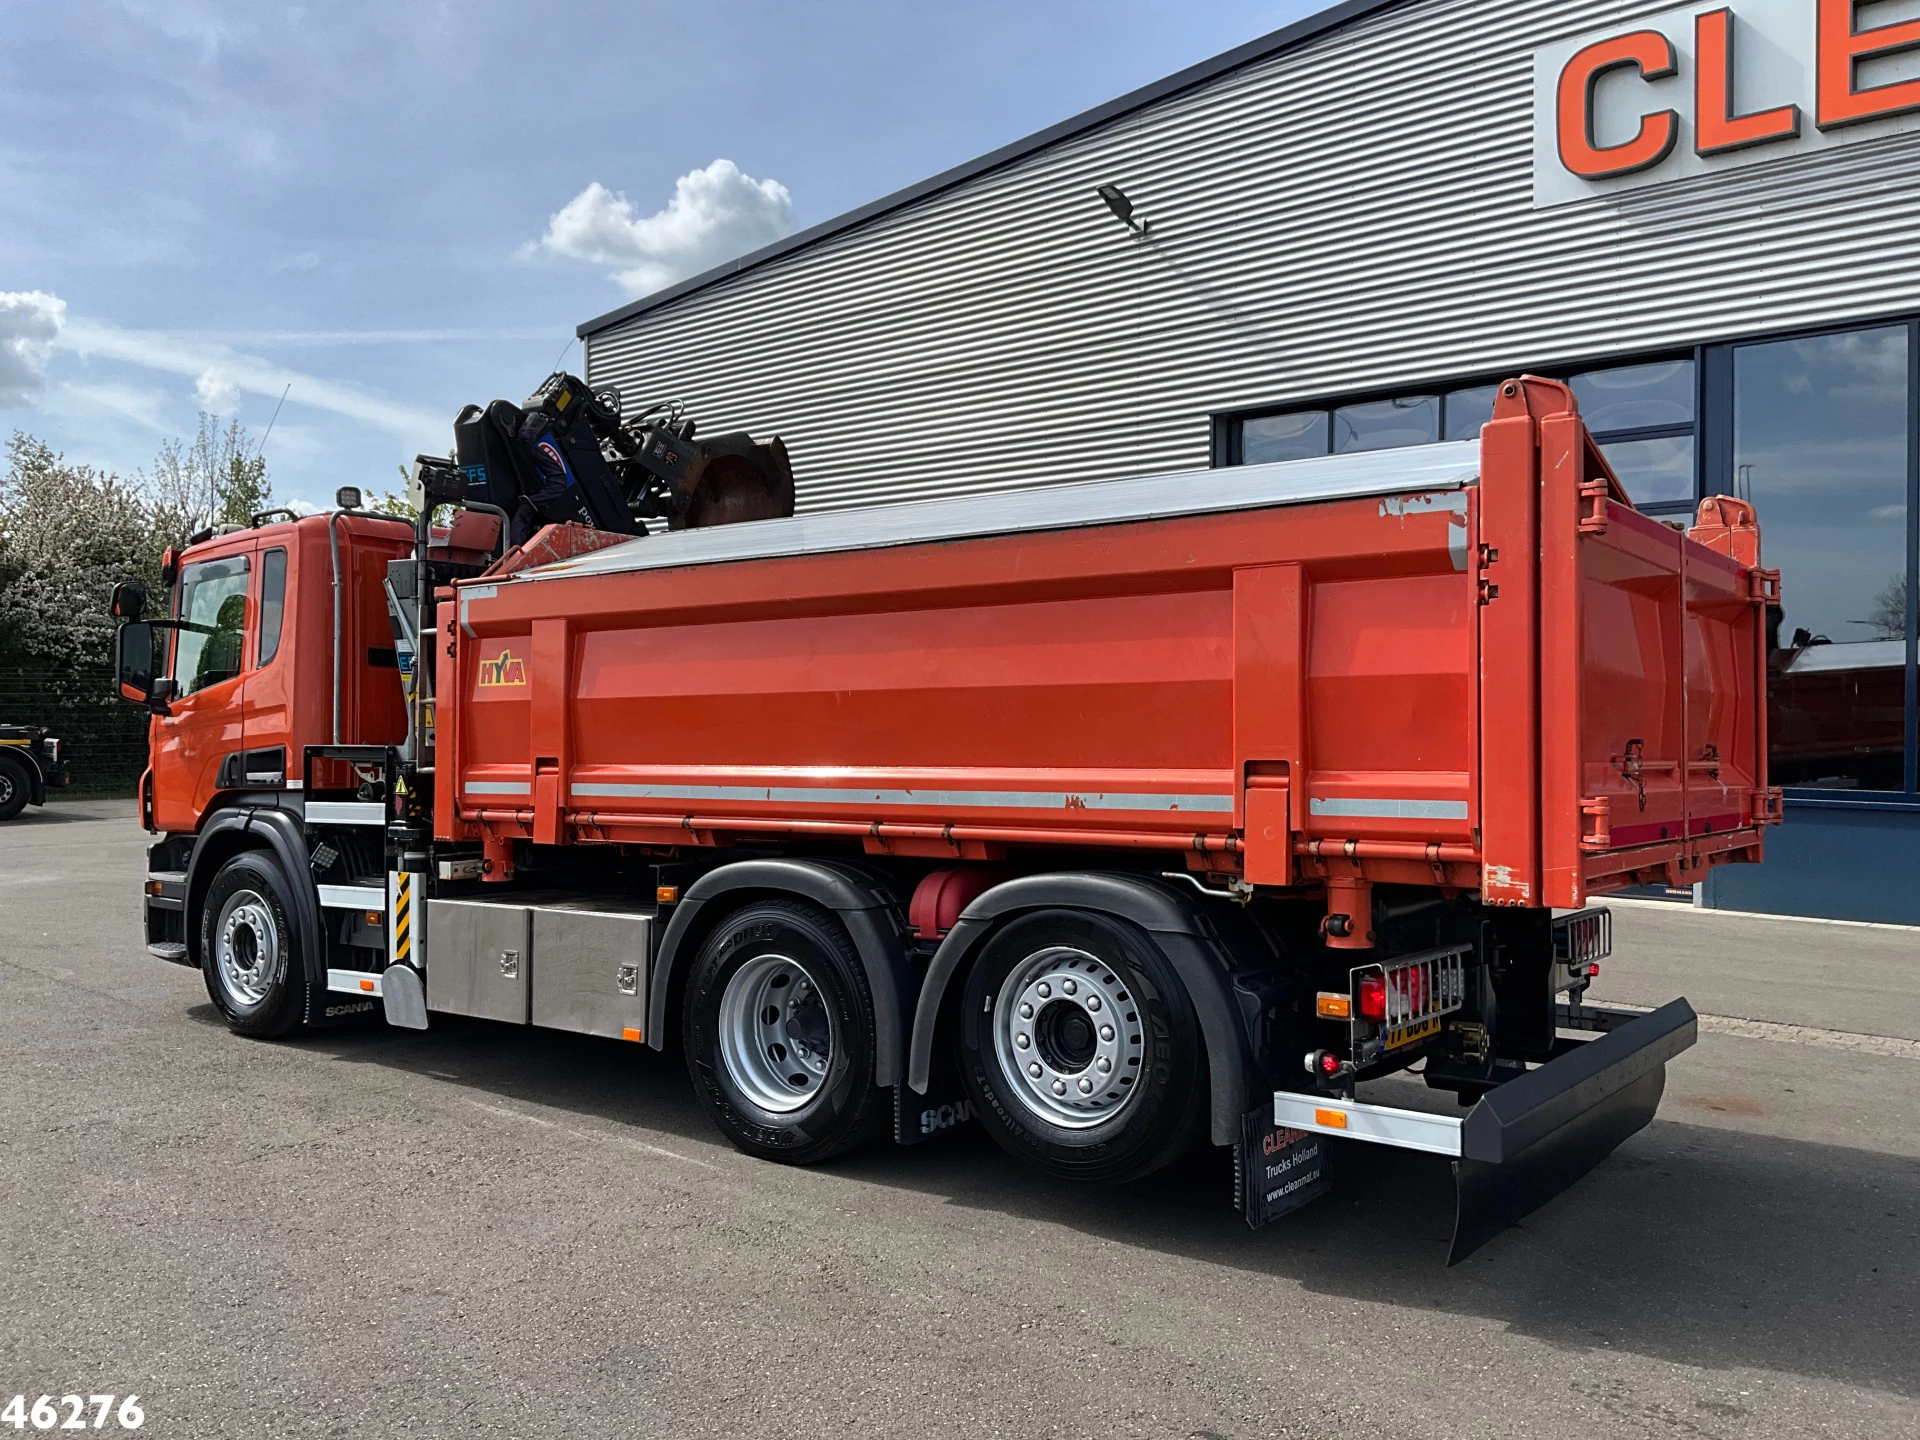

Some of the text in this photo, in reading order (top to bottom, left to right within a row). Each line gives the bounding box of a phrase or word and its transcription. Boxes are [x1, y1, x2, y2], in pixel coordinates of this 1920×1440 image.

[481, 653, 525, 684] HYVA
[325, 1001, 375, 1017] SCANIA
[1265, 1141, 1319, 1180] Trucks Holland
